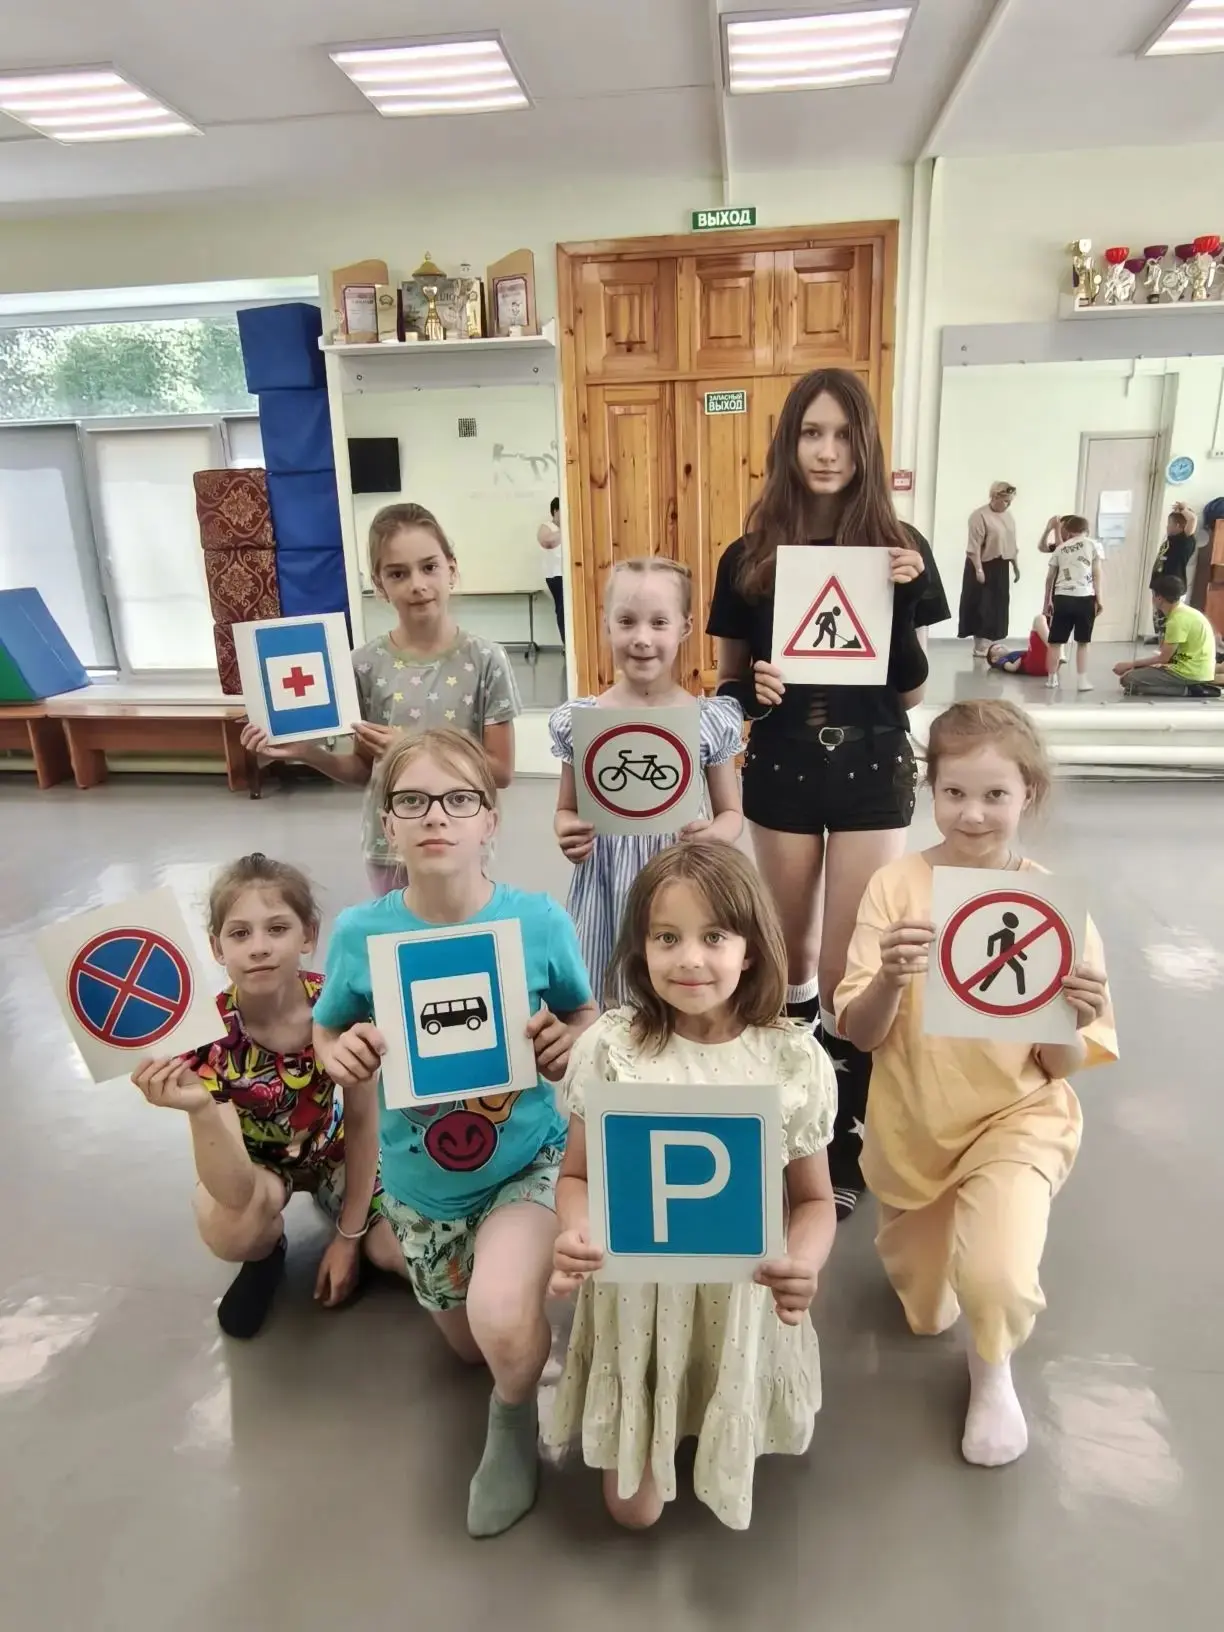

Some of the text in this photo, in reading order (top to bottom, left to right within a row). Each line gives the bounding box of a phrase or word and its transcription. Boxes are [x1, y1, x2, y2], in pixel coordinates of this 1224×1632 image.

[698, 209, 751, 227] ВЫХОД
[709, 400, 743, 411] ВЫХОД
[650, 1129, 731, 1243] P
